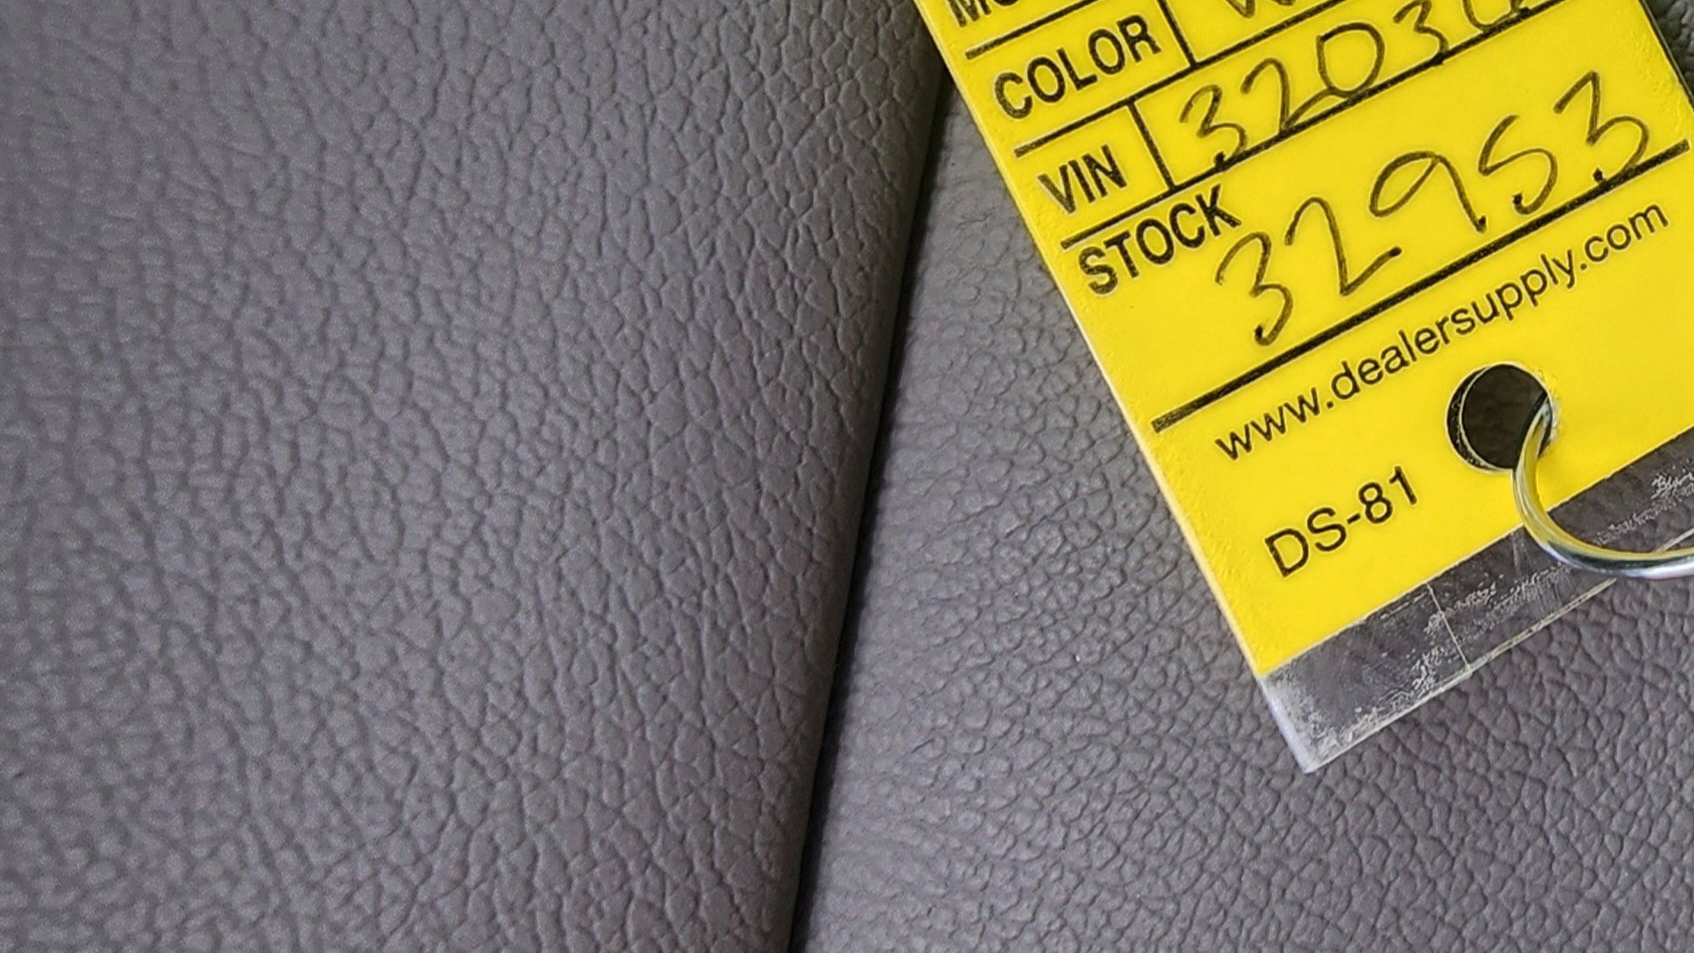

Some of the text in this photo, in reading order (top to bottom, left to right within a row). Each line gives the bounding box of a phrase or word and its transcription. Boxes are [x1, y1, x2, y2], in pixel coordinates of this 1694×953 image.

[991, 12, 1163, 120] COLOR
[1037, 143, 1128, 216] VIN
[1214, 69, 1652, 347] 32953
[1077, 182, 1244, 296] STOCK
[1214, 201, 1670, 462] www.dealersupply.com
[1263, 465, 1419, 580] DS-81
